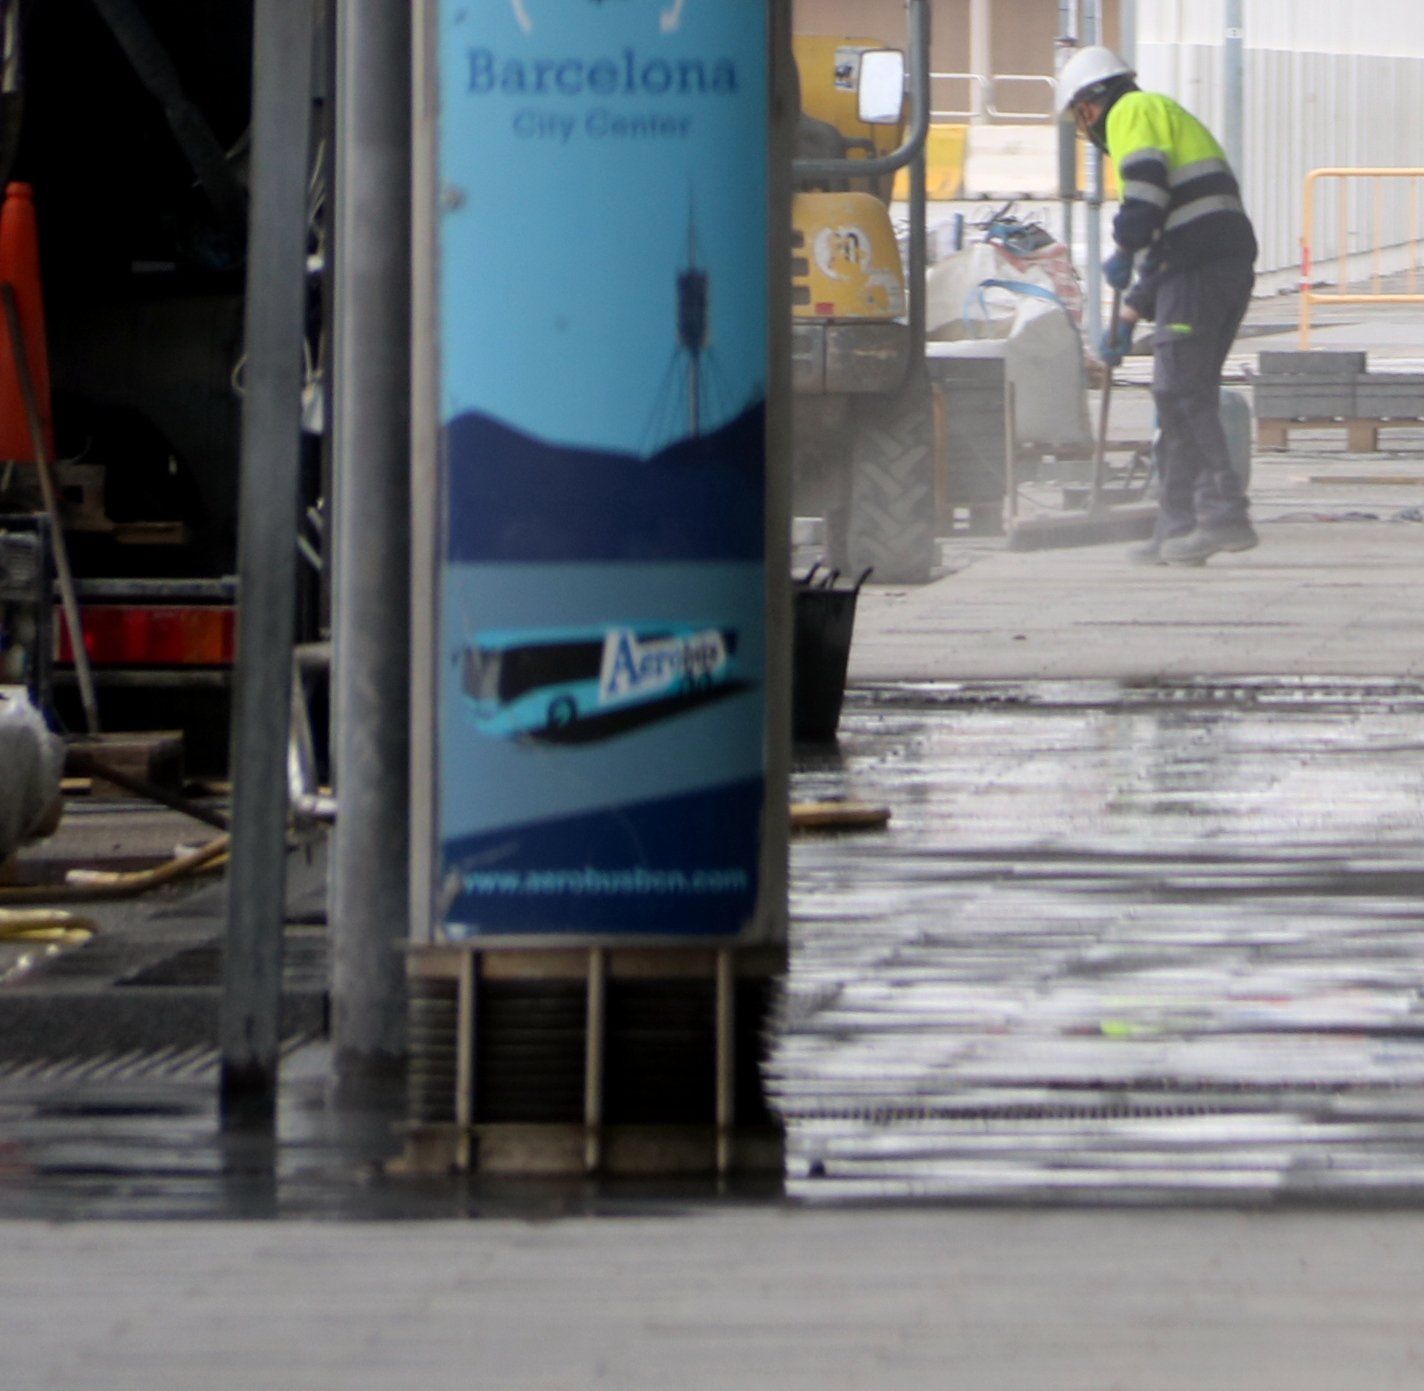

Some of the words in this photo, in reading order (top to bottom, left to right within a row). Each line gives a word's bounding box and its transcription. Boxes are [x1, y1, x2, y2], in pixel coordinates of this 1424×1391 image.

[467, 46, 739, 96] Barcelona
[512, 106, 576, 144] City
[584, 106, 691, 138] Center
